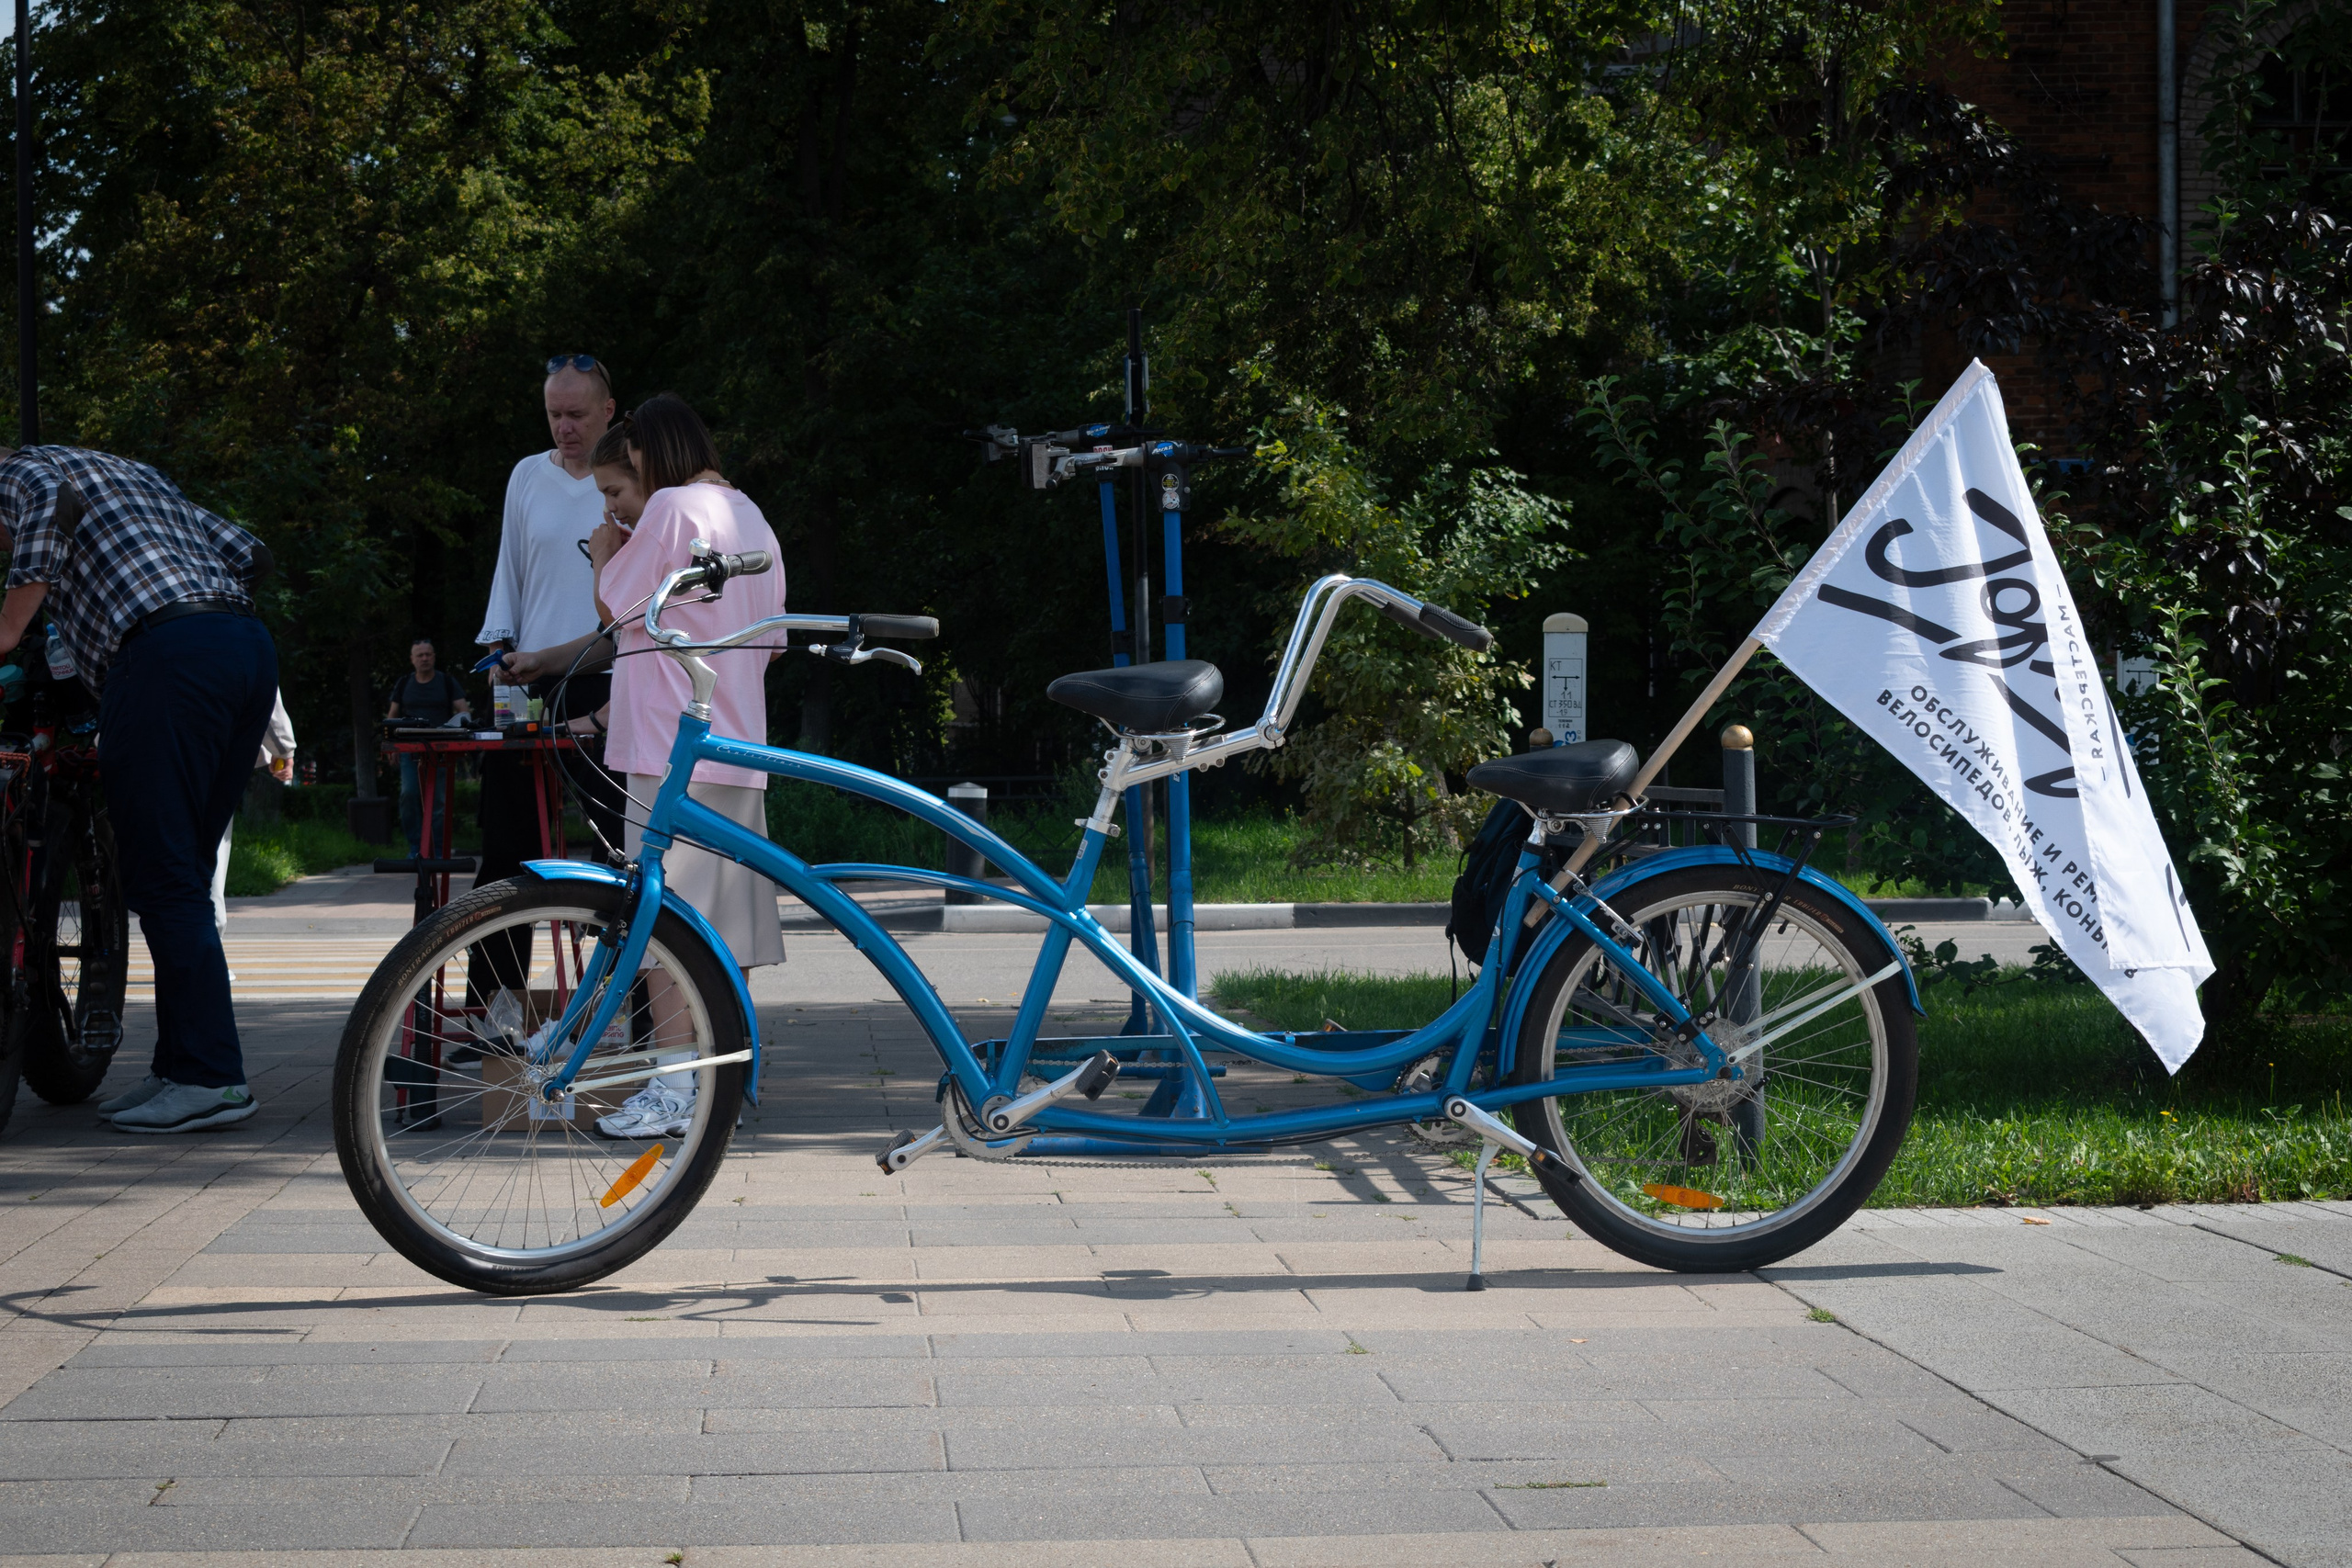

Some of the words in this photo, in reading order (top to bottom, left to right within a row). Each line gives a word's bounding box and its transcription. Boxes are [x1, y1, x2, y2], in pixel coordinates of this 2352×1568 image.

[1876, 689, 2012, 832] ВЕЛОСИПЕДОВ,
[2013, 832, 2049, 893] ЛЫЖ,
[2052, 887, 2139, 979] КОНЬВ
[1911, 685, 2044, 845] ОБСЛУЖИВАНИЕ
[2041, 842, 2063, 863] И
[397, 936, 443, 987] BONTRAGER
